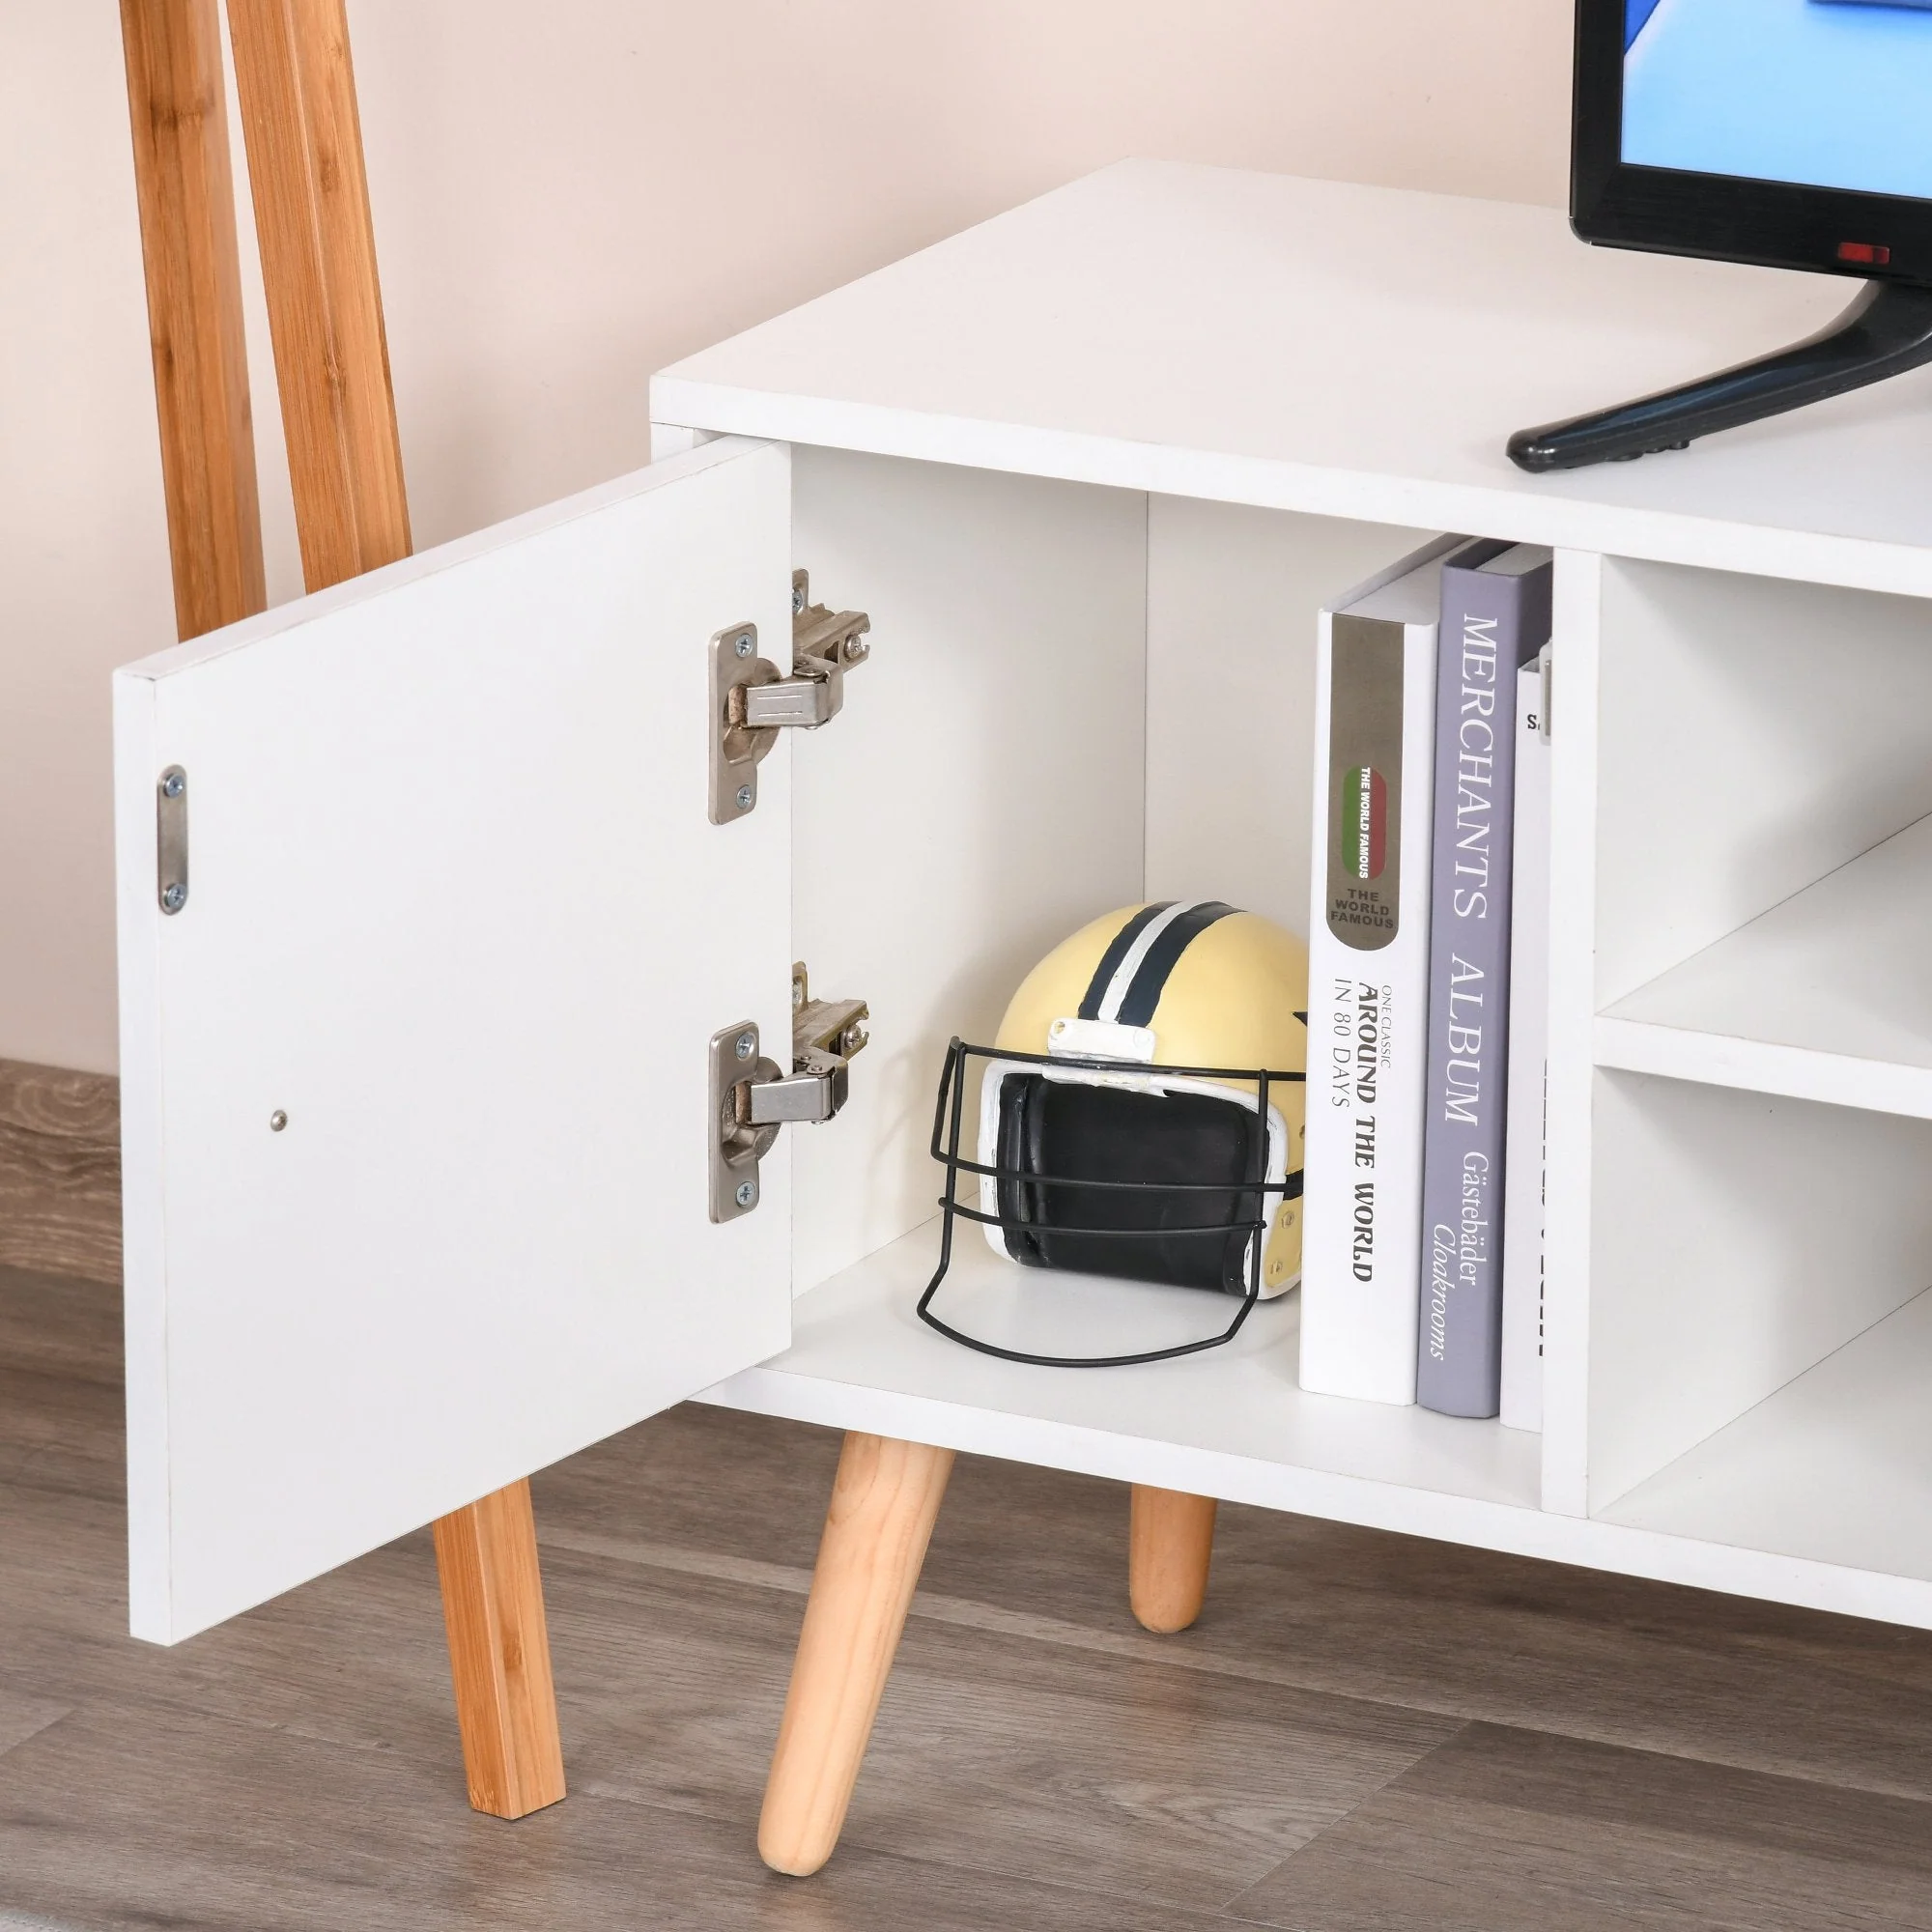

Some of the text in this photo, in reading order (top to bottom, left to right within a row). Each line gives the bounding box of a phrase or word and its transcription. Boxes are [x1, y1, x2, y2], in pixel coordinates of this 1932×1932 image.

[1358, 766, 1371, 880] THE WORLD FAMOUS
[1445, 613, 1498, 1126] MERCHANTS ALBUM
[1330, 911, 1393, 929] FAMOUS
[1335, 899, 1389, 916] WORLD
[1348, 888, 1379, 902] THE
[1332, 979, 1352, 1108] IN 80 DAYS
[1379, 984, 1392, 1068] ONE CLASSIC
[1353, 981, 1378, 1283] AROUND THE WORLD
[1459, 1151, 1489, 1286] Gästebäder
[1431, 1224, 1456, 1361] Cloakrooms
